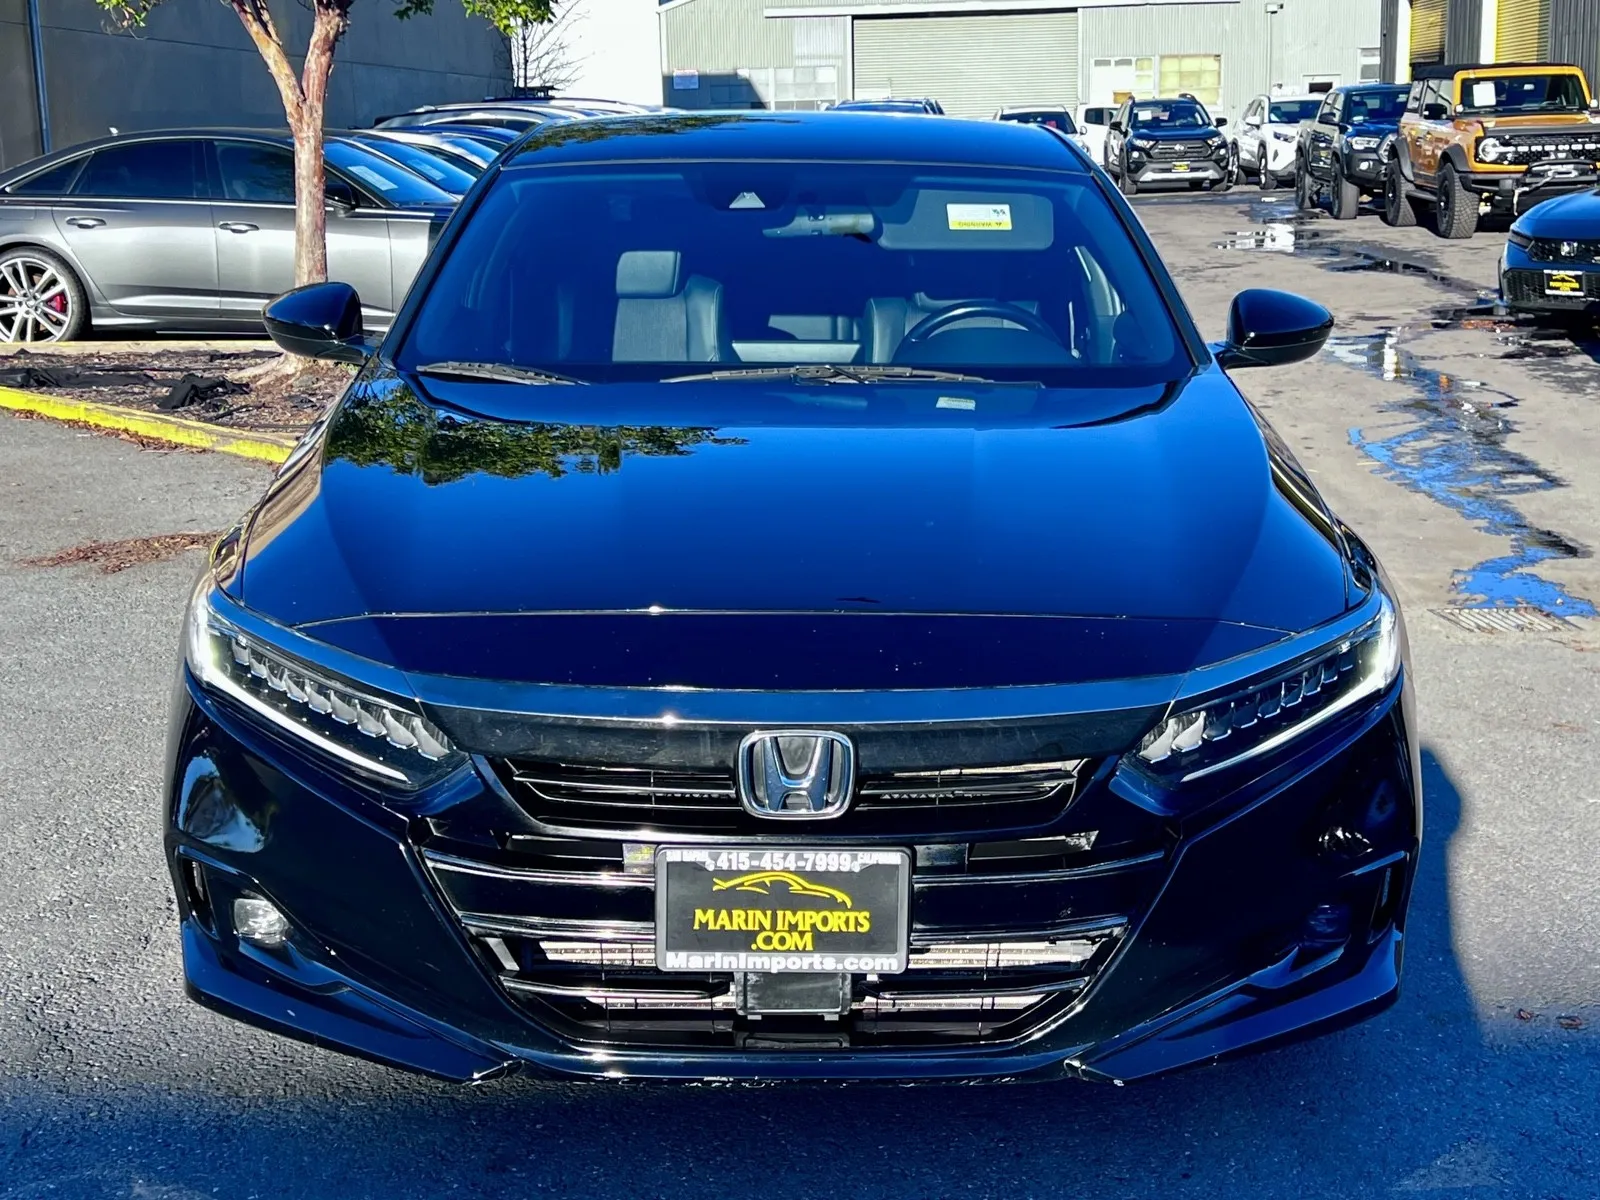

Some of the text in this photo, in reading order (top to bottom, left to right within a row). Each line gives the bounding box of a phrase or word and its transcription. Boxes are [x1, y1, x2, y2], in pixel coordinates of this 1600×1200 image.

[716, 851, 852, 872] 415-454-7999
[693, 909, 871, 932] MARIN IMPORTS
[750, 931, 814, 951] .COM
[666, 952, 898, 973] MarinImports.com
